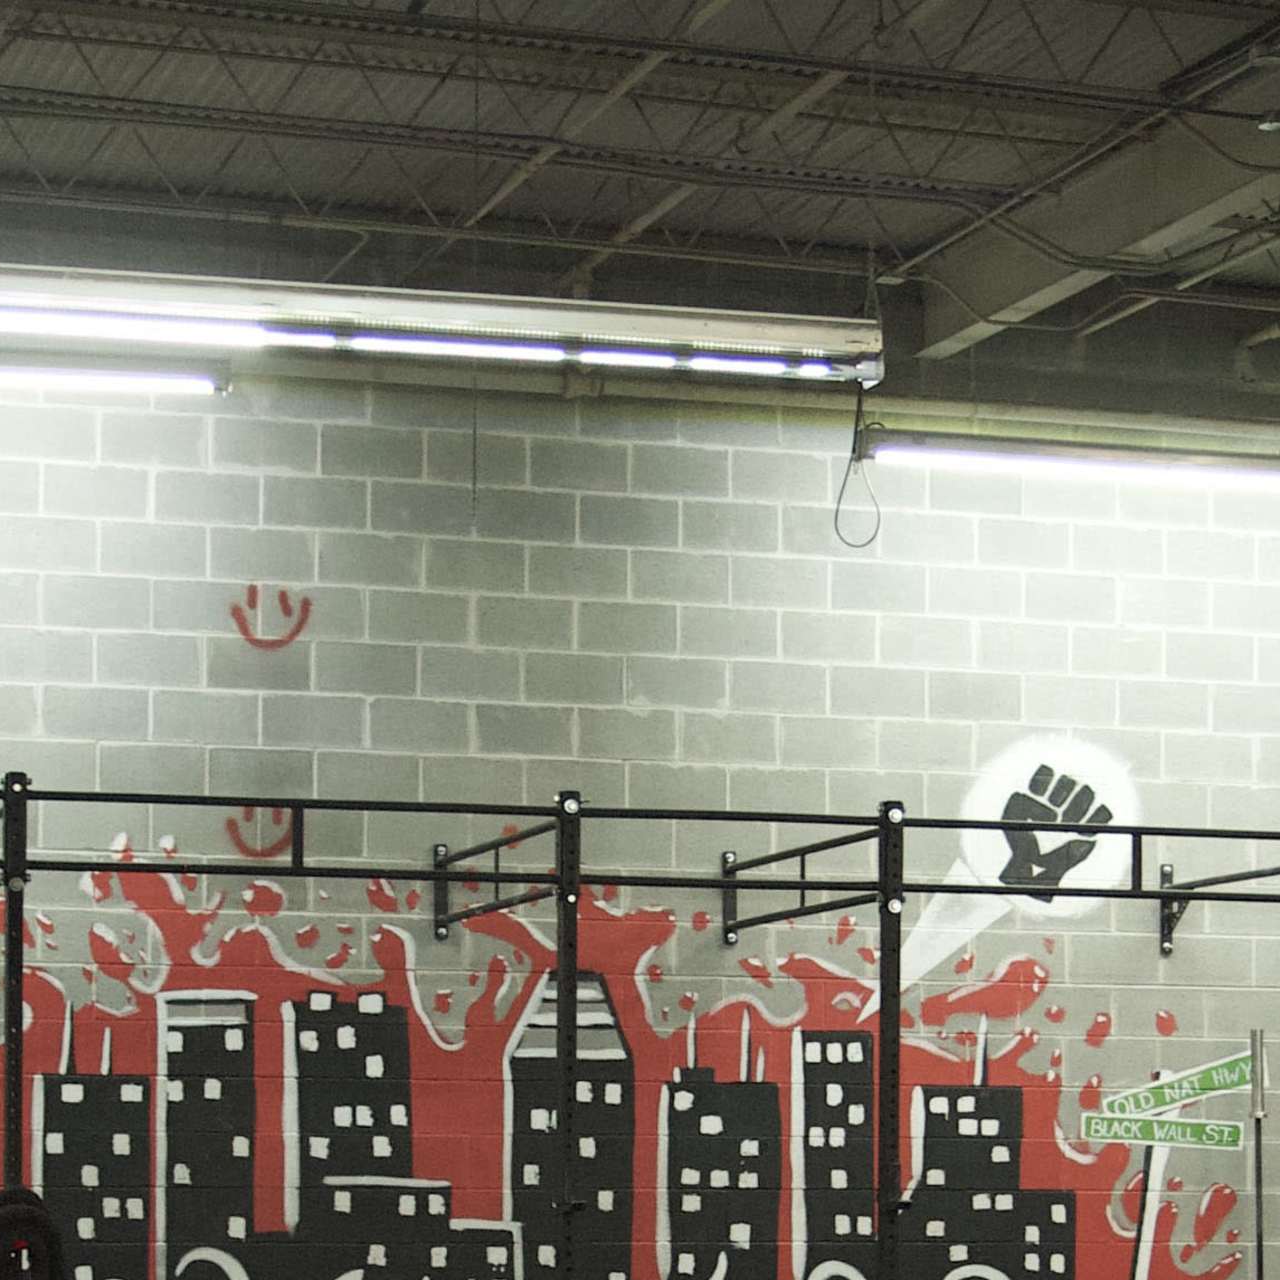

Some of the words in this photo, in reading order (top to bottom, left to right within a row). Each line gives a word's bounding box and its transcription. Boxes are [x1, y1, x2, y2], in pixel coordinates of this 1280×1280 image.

[1113, 1091, 1156, 1115] OLD
[1163, 1073, 1206, 1101] NAT
[1211, 1061, 1252, 1087] HWY
[1090, 1118, 1144, 1138] BLACK
[1152, 1121, 1198, 1142] WALL
